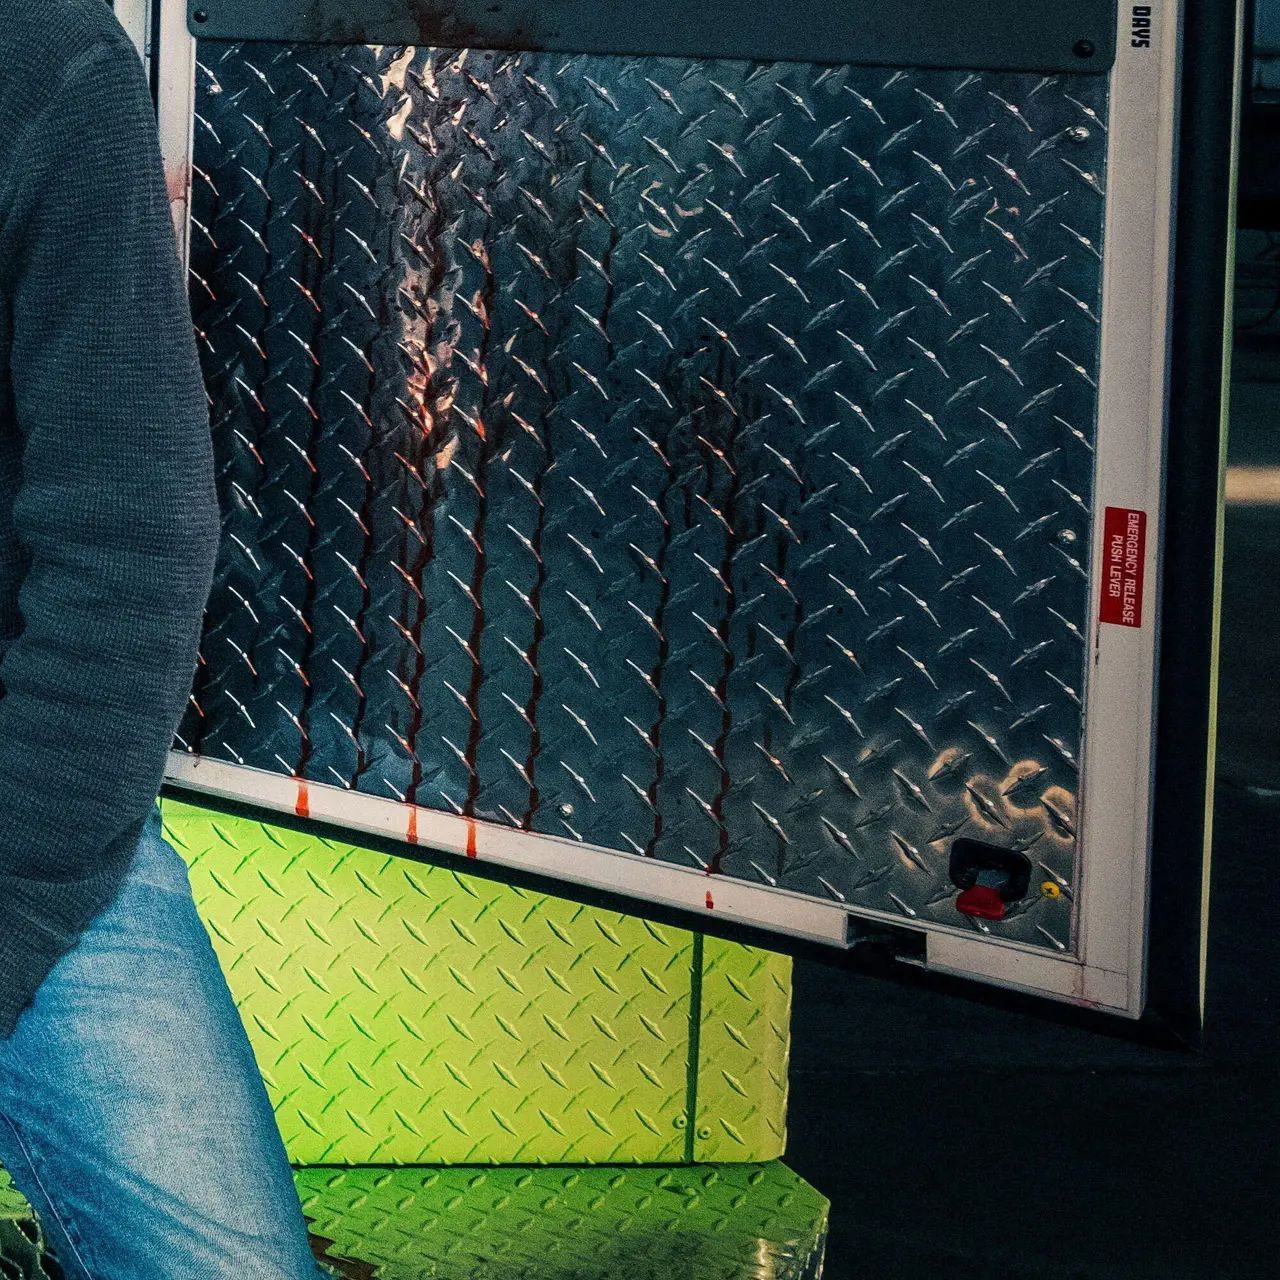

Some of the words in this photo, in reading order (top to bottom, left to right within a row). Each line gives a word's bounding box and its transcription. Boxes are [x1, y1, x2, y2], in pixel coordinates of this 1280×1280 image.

[1131, 6, 1151, 48] DAYS
[1111, 534, 1124, 562] PUSH
[1125, 513, 1139, 576] EMERGENCY
[1109, 565, 1122, 598] LEVER
[1122, 578, 1136, 625] RELEASE
